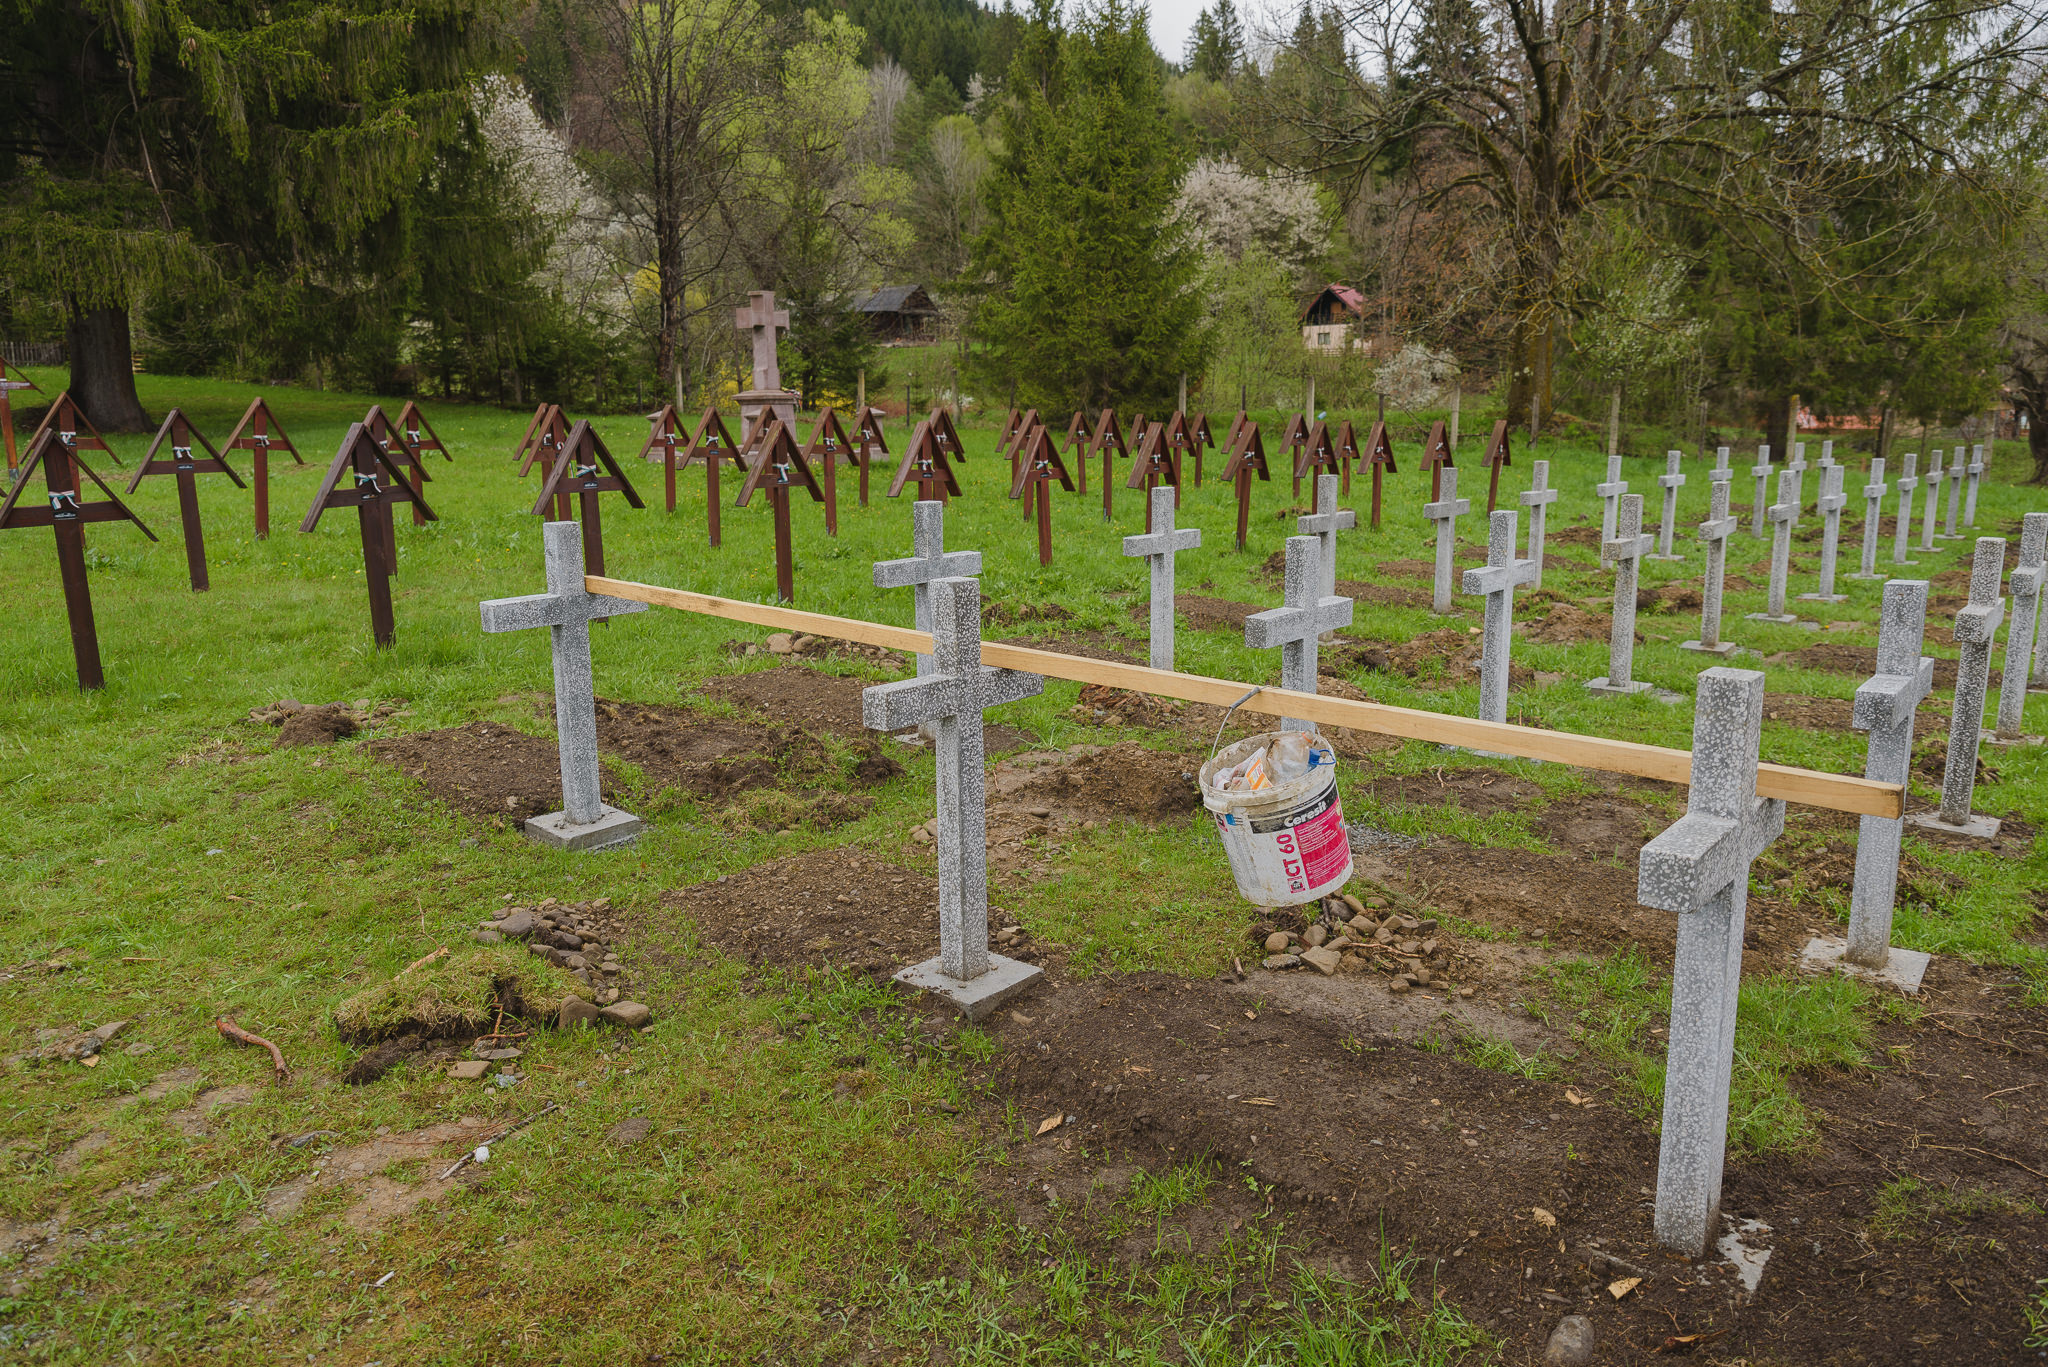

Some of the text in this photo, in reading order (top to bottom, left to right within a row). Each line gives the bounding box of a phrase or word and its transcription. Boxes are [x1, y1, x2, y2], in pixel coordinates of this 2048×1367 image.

[1284, 800, 1327, 828] Ceresit
[1276, 833, 1295, 854] 60
[1283, 859, 1301, 877] CT
